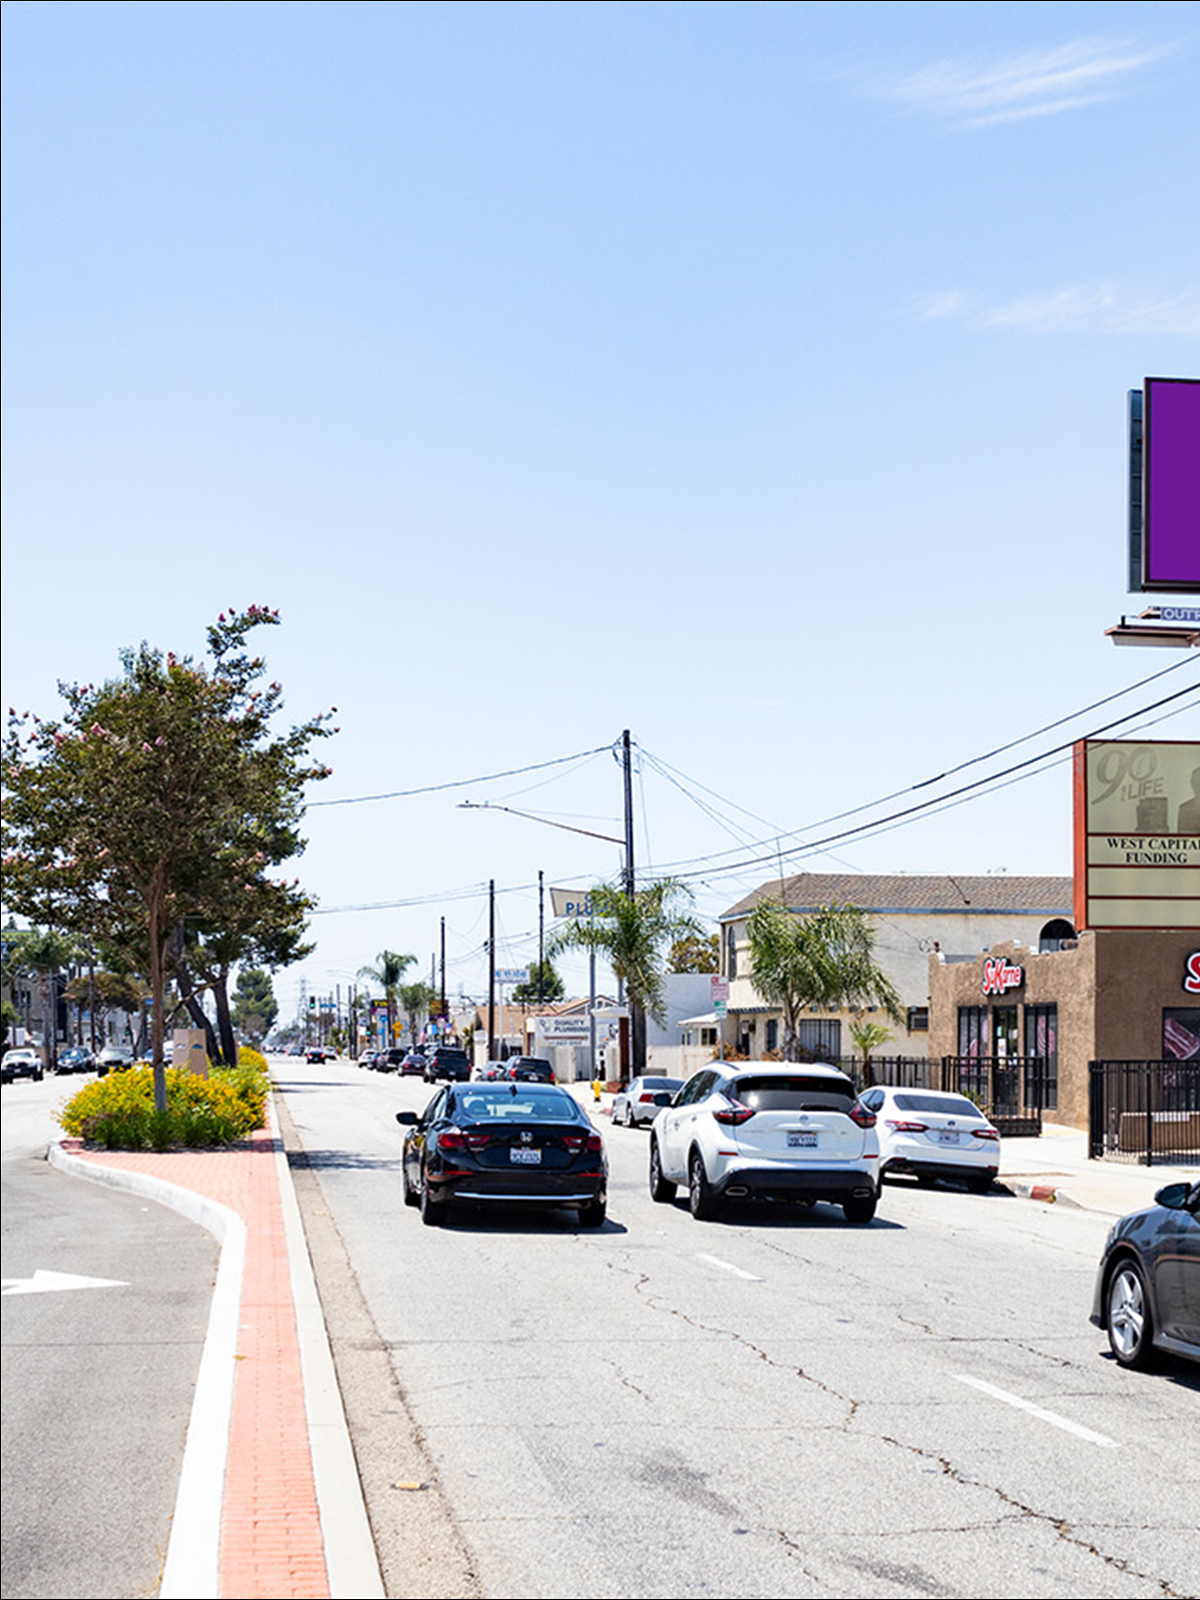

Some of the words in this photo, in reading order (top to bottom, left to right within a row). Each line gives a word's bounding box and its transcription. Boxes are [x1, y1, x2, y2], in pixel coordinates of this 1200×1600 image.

[1091, 747, 1158, 805] 90
[1127, 777, 1165, 799] LIFE
[1107, 838, 1145, 849] WEST
[1125, 852, 1188, 864] FUNDING
